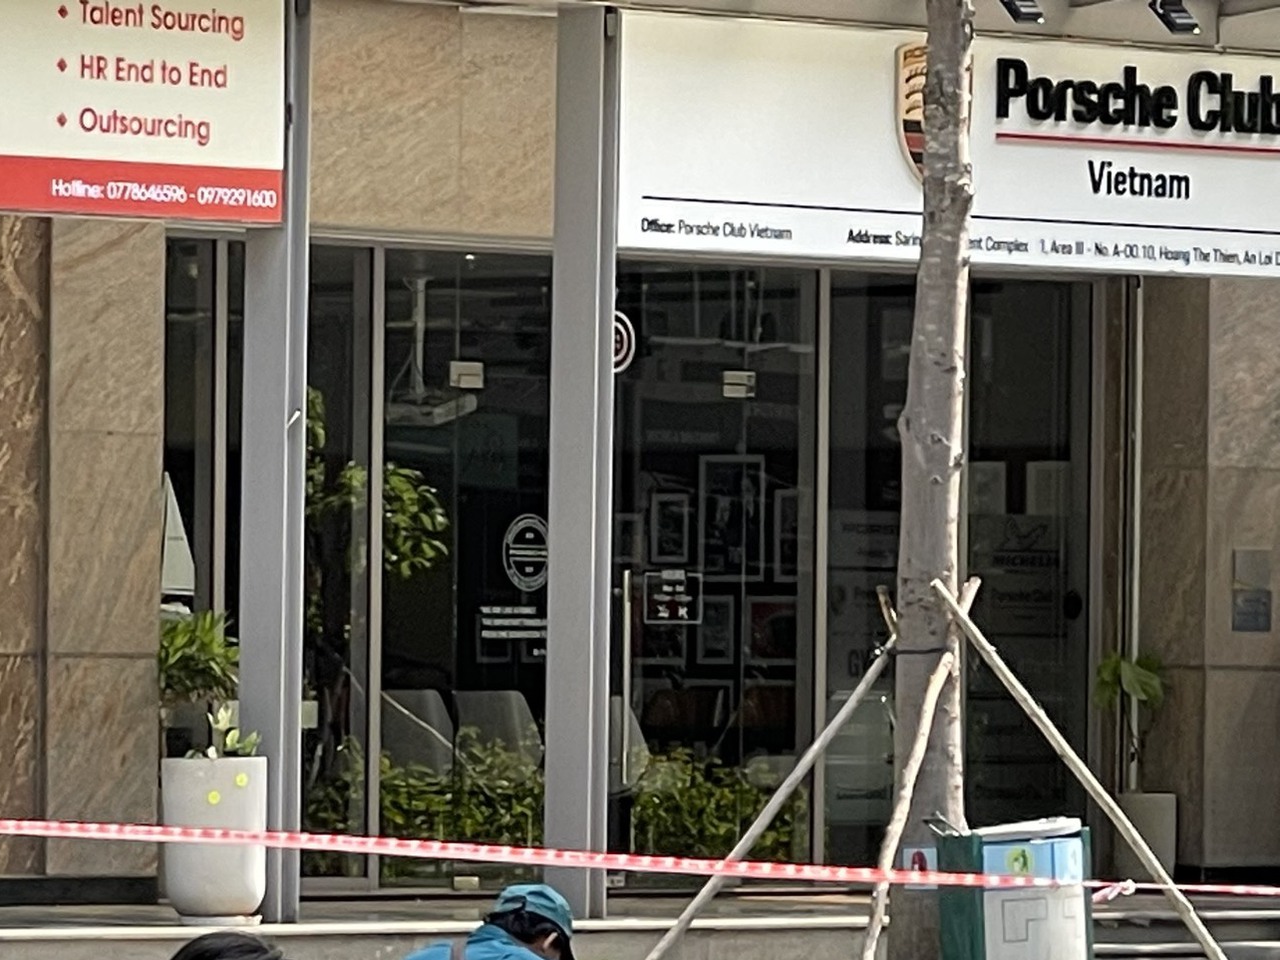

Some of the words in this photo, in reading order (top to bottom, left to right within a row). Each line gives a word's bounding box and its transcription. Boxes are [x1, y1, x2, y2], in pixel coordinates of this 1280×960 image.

[79, 0, 144, 27] Talent
[150, 5, 245, 41] Sourcing
[80, 54, 108, 80] HR
[115, 57, 154, 83] End
[161, 60, 182, 85] to
[189, 62, 227, 88] End
[996, 58, 1178, 128] Porsche
[1187, 70, 1280, 134] Club
[79, 107, 210, 146] Outsourcing
[1087, 160, 1190, 200] Vietnam
[678, 220, 720, 237] Porsche
[723, 222, 746, 238] Club
[748, 223, 792, 240] Vietnam
[895, 231, 921, 247] Sarin
[1050, 240, 1073, 254] Area
[1193, 247, 1211, 262] The
[1243, 250, 1257, 264] An
